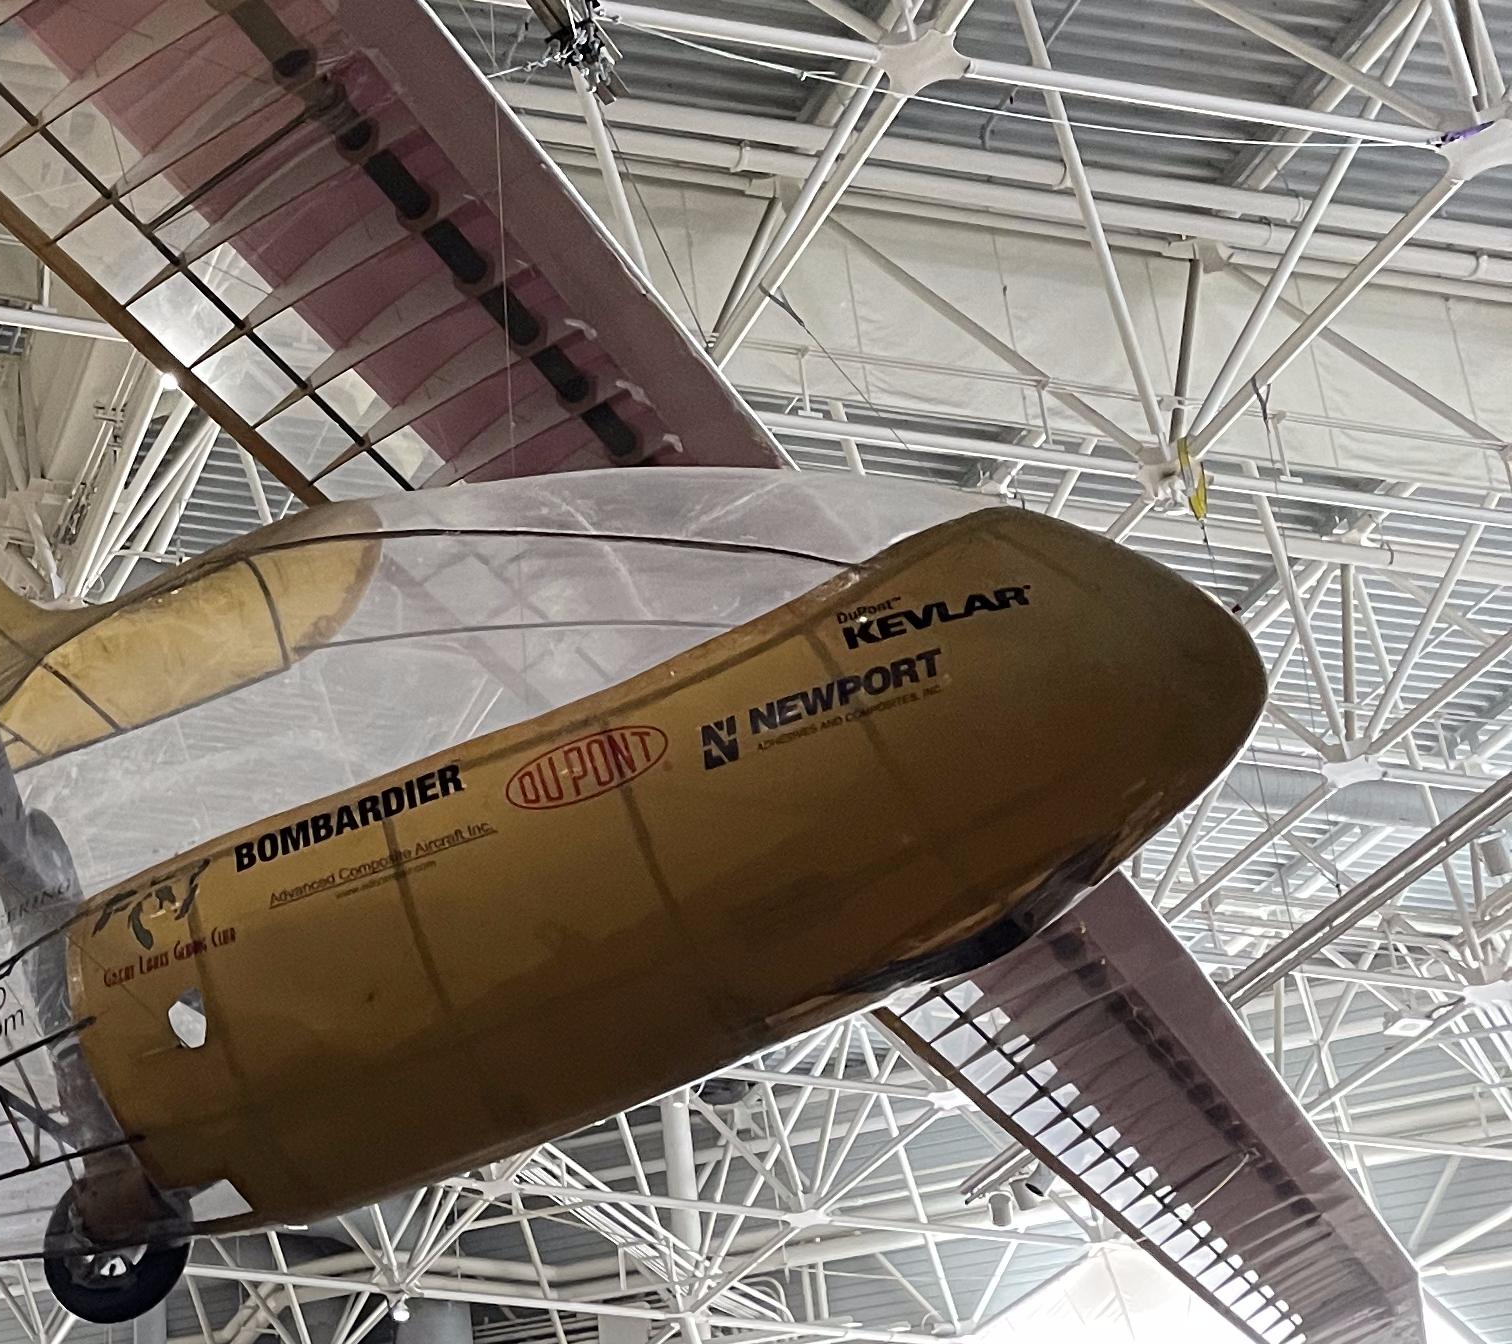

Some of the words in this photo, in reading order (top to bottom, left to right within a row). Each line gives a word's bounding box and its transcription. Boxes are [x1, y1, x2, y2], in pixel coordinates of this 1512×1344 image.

[843, 585, 1030, 650] KEVLAR
[749, 648, 941, 735] NEWPORT
[234, 764, 465, 873] BOMBARDIER
[271, 872, 336, 904] Advanced
[414, 828, 465, 856] Aircraft
